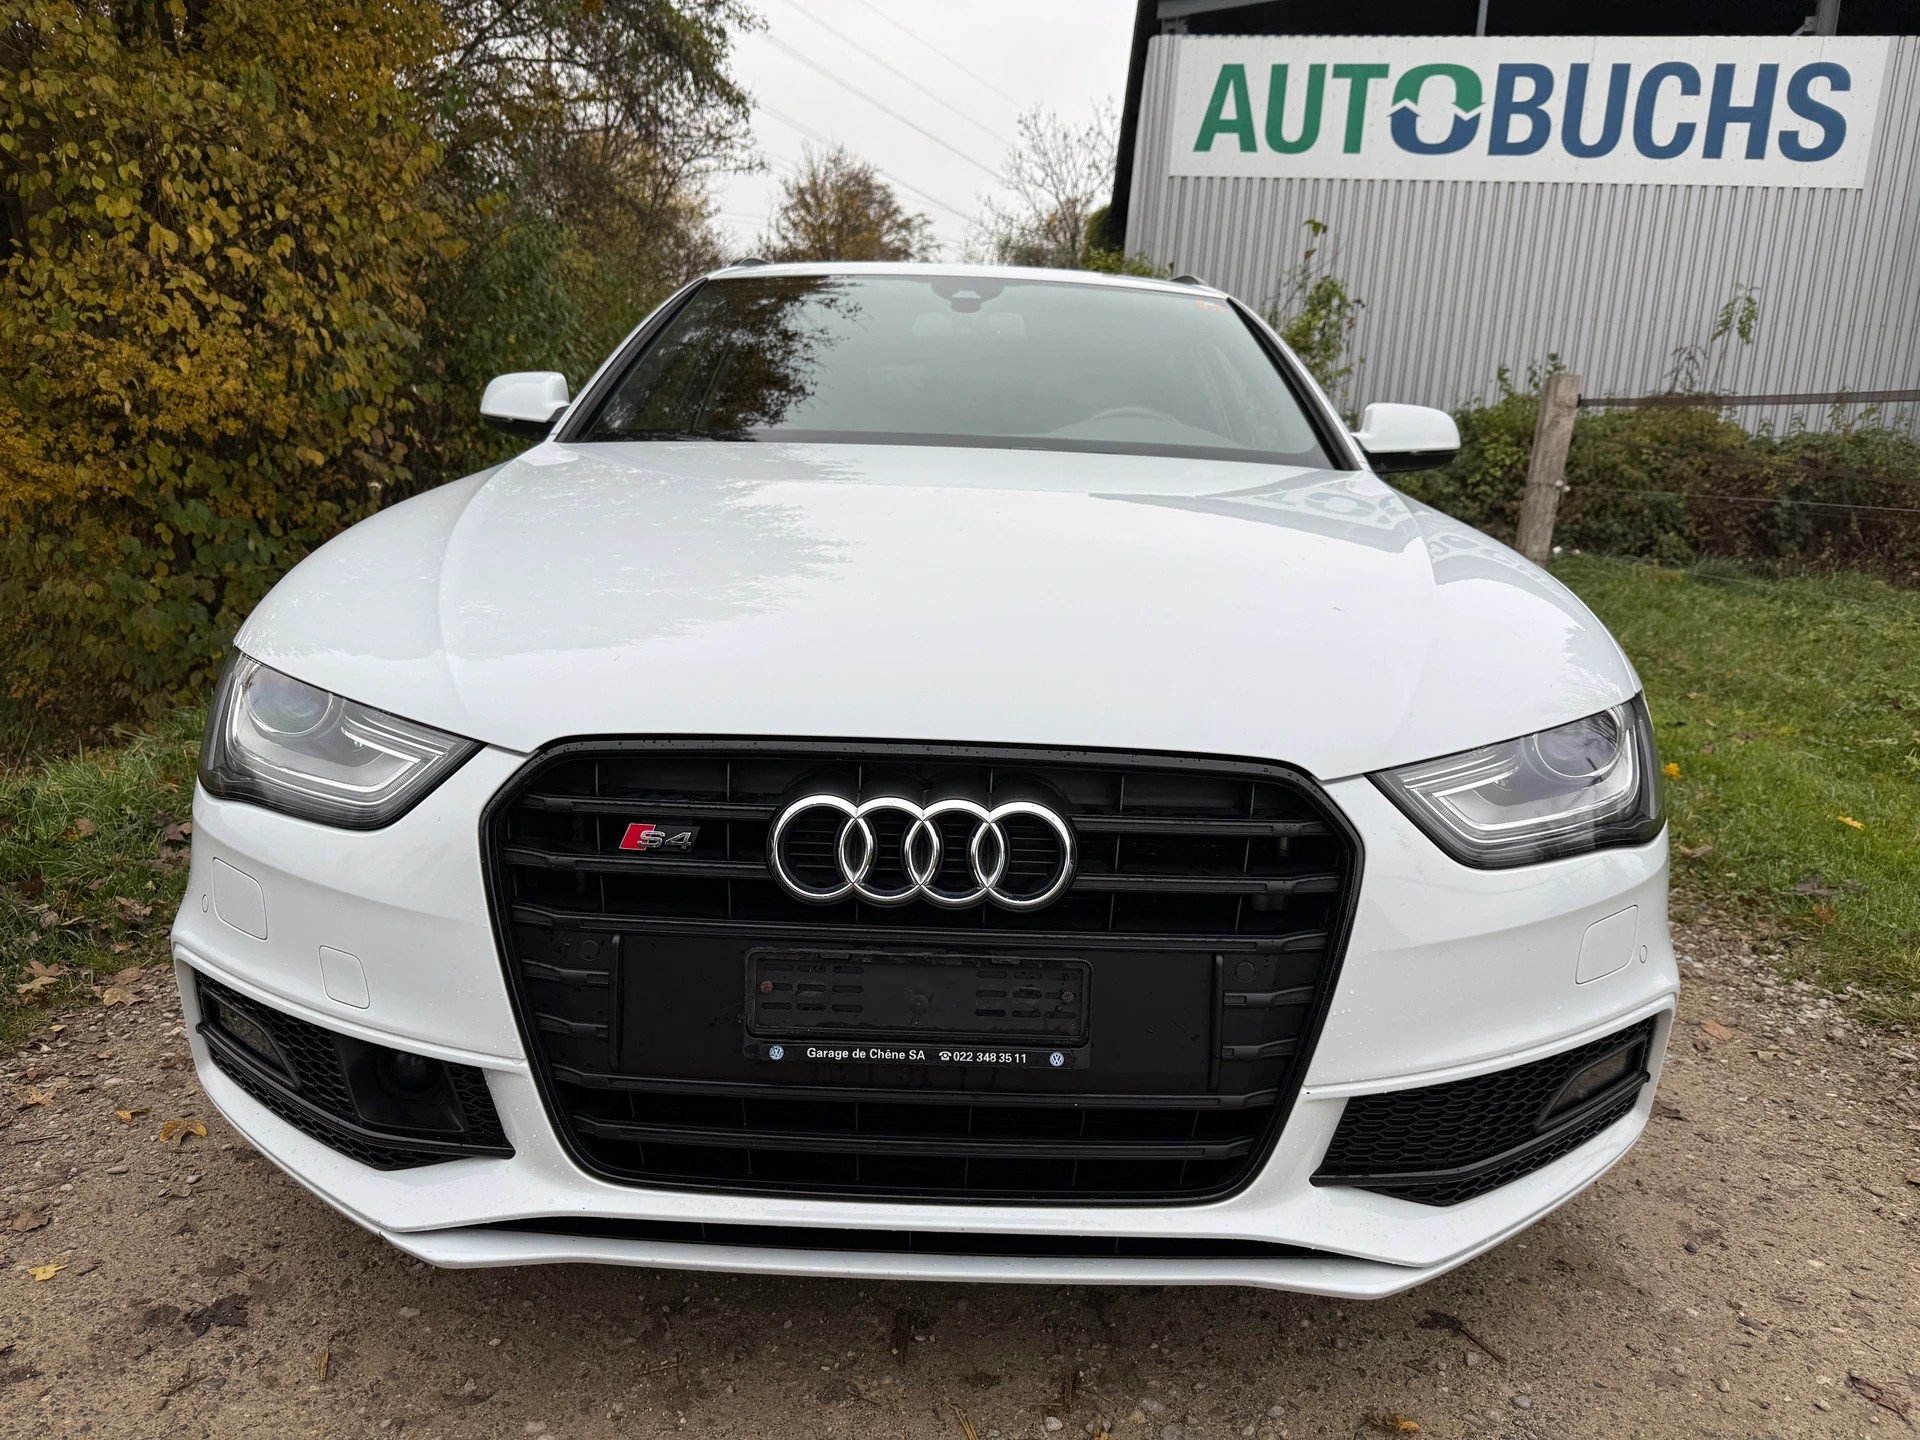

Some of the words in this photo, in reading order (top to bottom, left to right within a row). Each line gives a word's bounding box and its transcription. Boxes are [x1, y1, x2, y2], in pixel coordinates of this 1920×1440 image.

[1193, 62, 1851, 162] AUTOBUCHS
[637, 830, 692, 849] S4
[806, 1047, 849, 1060] Garage
[852, 1048, 866, 1059] de
[869, 1049, 906, 1060] Chêne
[908, 1050, 925, 1060] SA
[953, 1051, 973, 1062] 022
[976, 1052, 997, 1063] 348
[998, 1053, 1012, 1063] 35
[1014, 1053, 1026, 1063] 11
